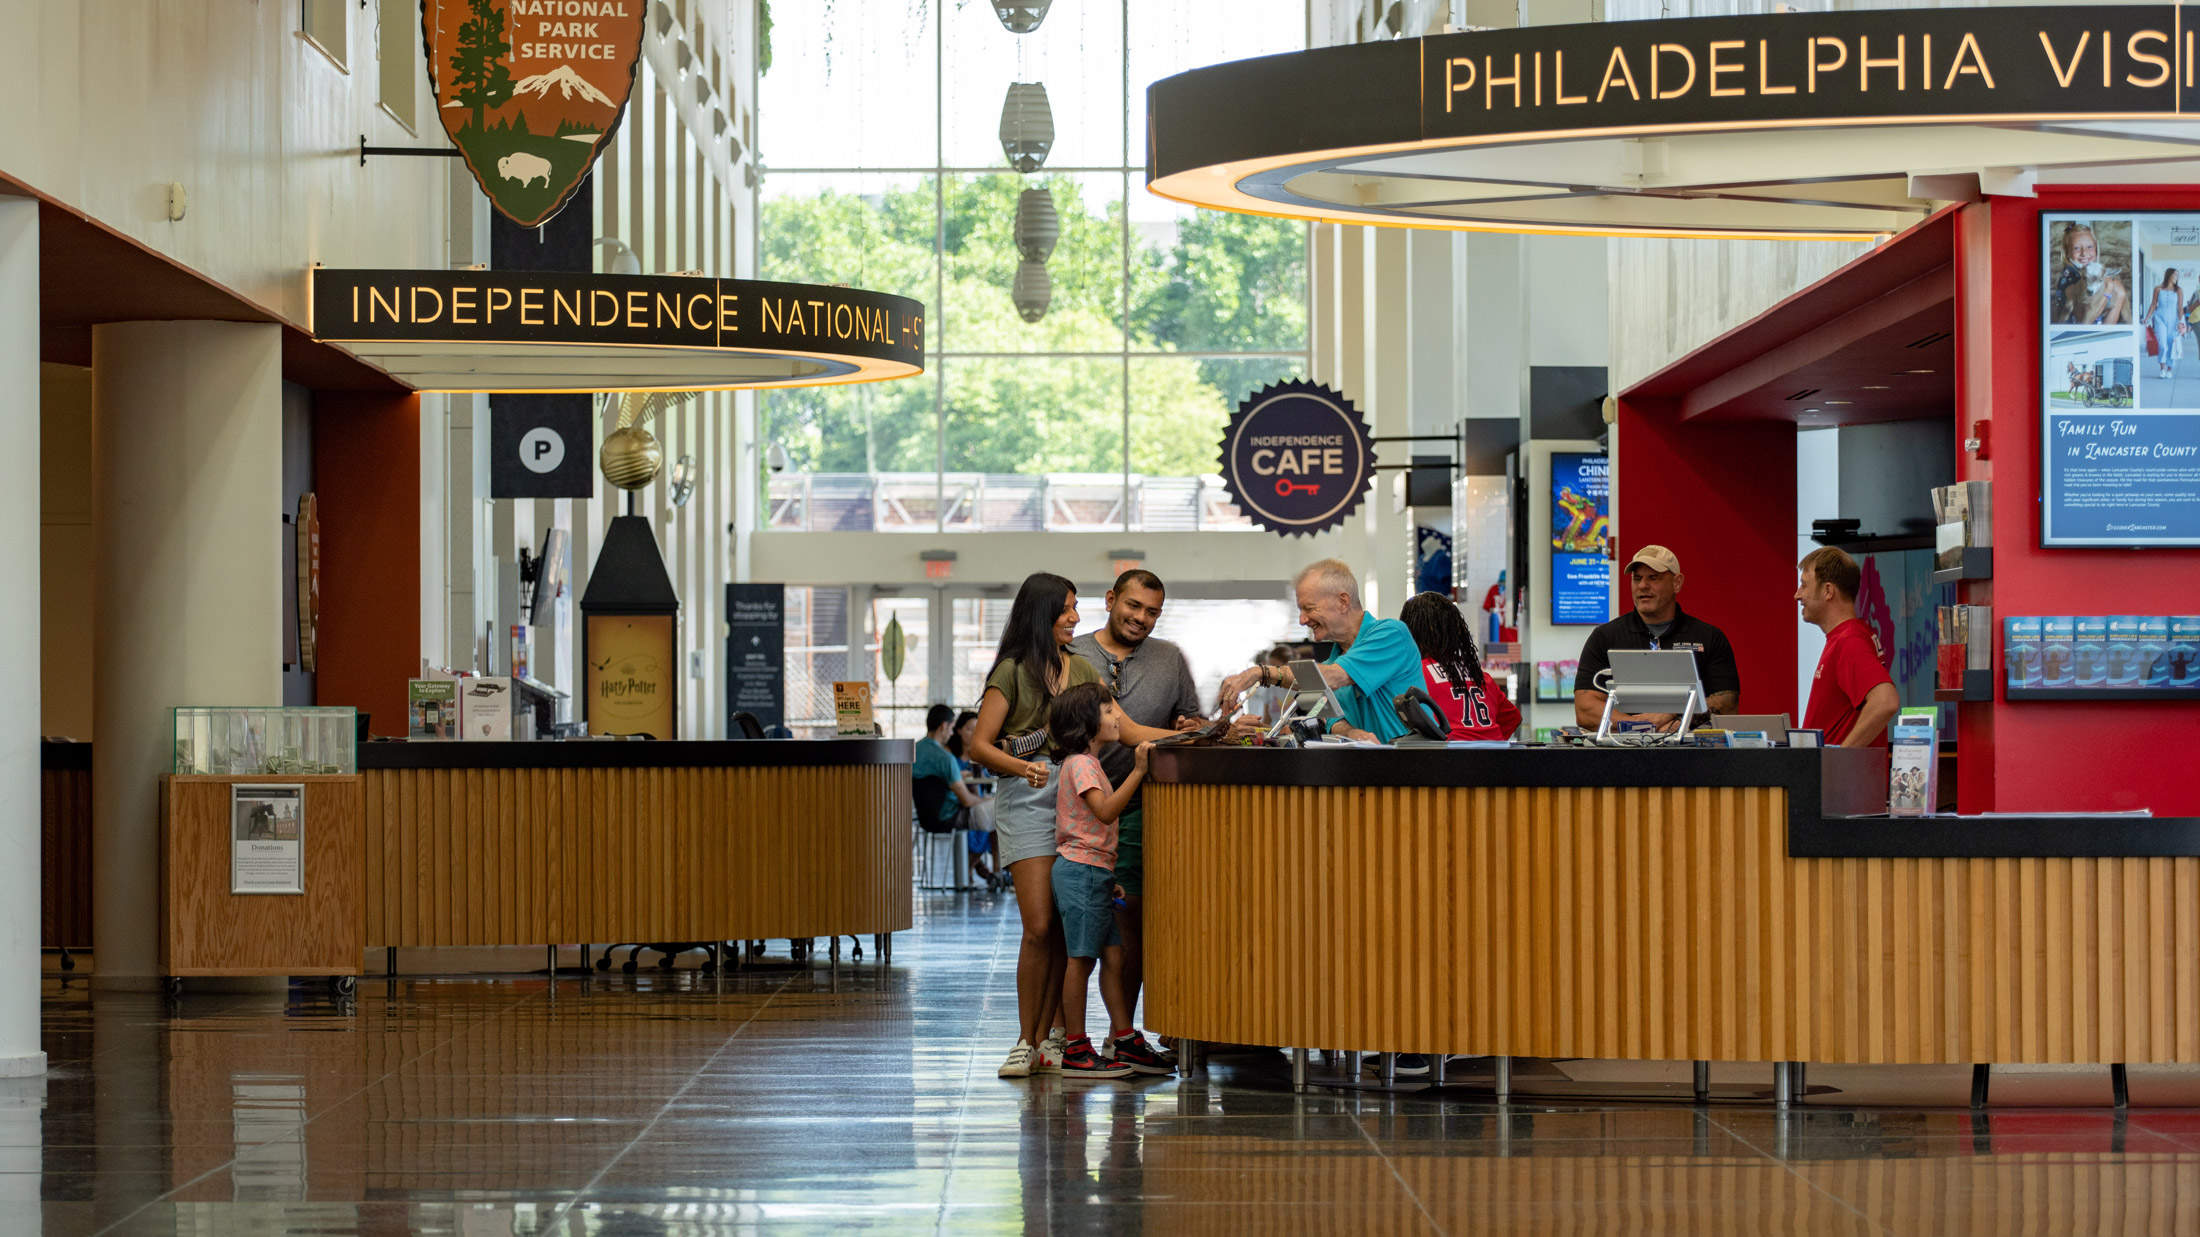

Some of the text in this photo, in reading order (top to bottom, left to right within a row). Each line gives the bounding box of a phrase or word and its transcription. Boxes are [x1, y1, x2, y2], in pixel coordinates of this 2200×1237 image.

[512, 0, 629, 17] NATIONAL
[539, 22, 599, 38] PARK
[521, 43, 616, 60] SERVICE
[1446, 29, 2194, 113] PHILADELPHIA VISI
[353, 286, 738, 331] INDEPENDENCE
[761, 297, 895, 345] NATIONAL
[534, 440, 552, 461] P
[1250, 435, 1344, 447] INDEPENDENCE
[1251, 448, 1344, 476] CAFE
[601, 677, 657, 699] Harry Potter
[837, 701, 861, 710] HERE
[1450, 686, 1492, 728] 76
